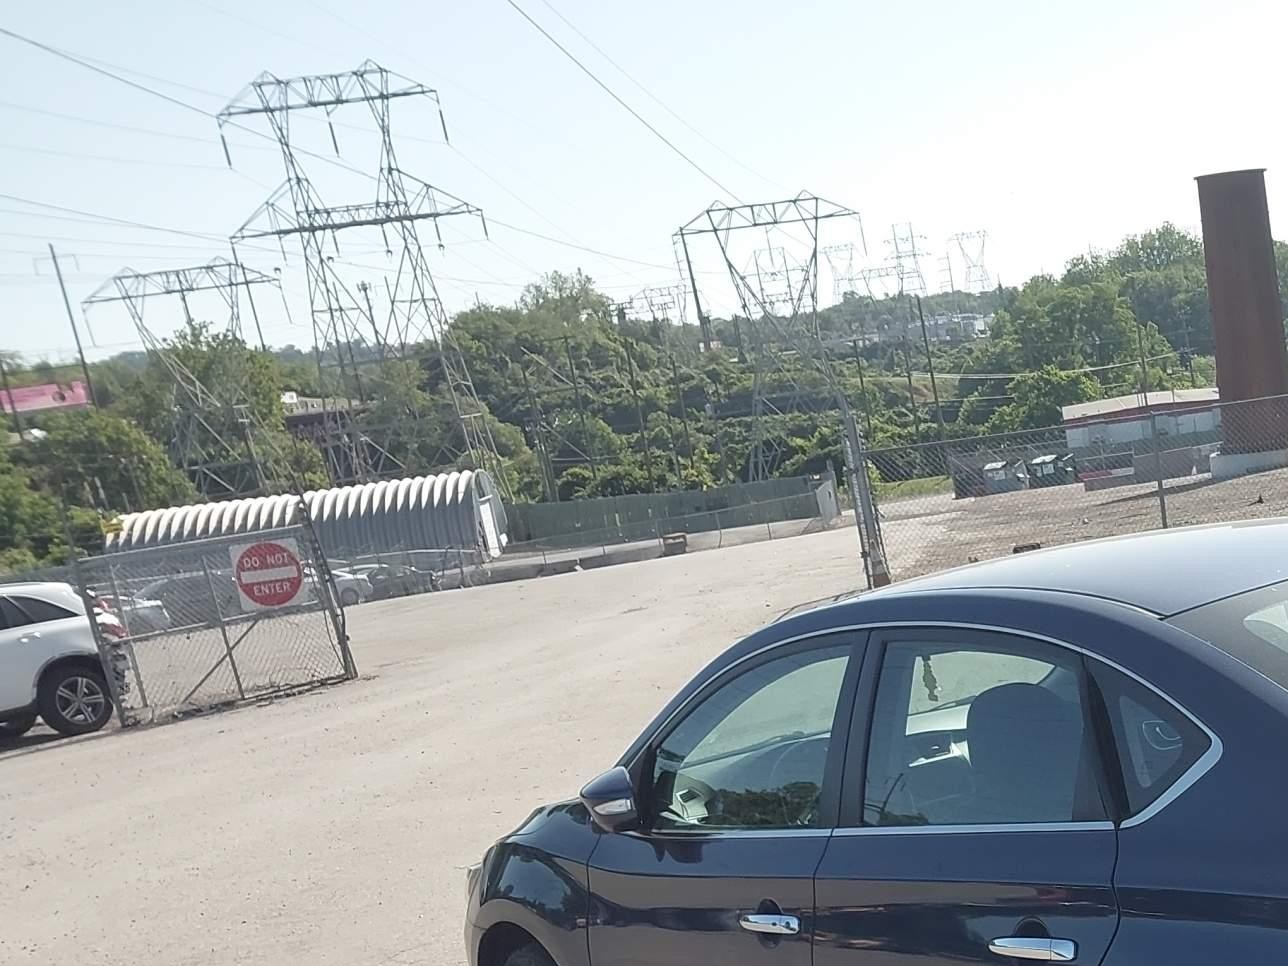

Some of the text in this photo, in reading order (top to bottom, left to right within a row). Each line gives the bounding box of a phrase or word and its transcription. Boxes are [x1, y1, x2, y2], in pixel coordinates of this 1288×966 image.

[243, 552, 289, 569] DO NOT
[253, 581, 292, 597] ENTER
